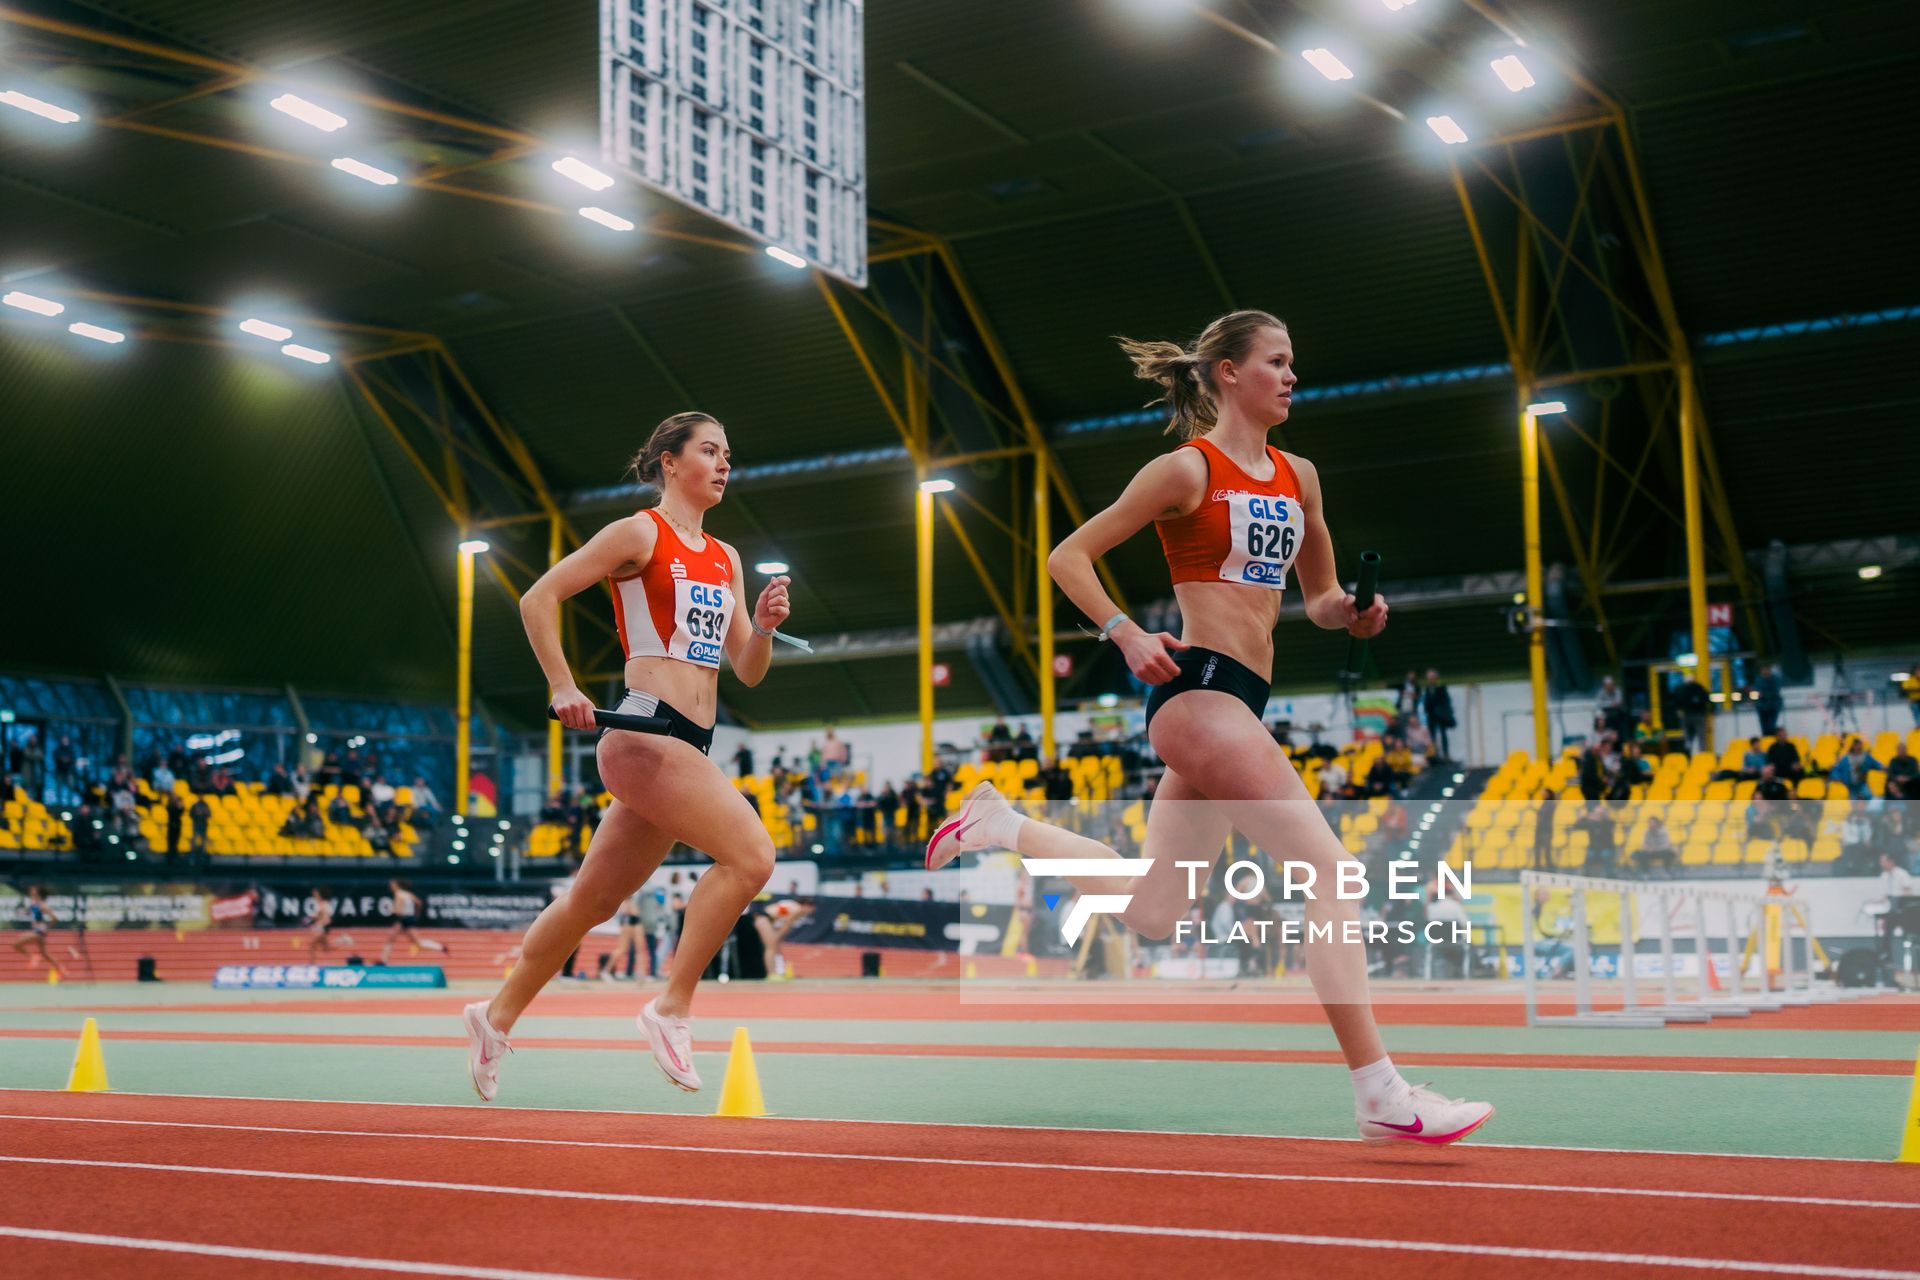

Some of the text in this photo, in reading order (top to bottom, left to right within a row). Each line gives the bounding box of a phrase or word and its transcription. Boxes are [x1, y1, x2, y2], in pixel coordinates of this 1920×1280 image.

[1247, 522, 1295, 560] 626
[686, 607, 725, 641] 639
[281, 896, 412, 917] NOVAFO
